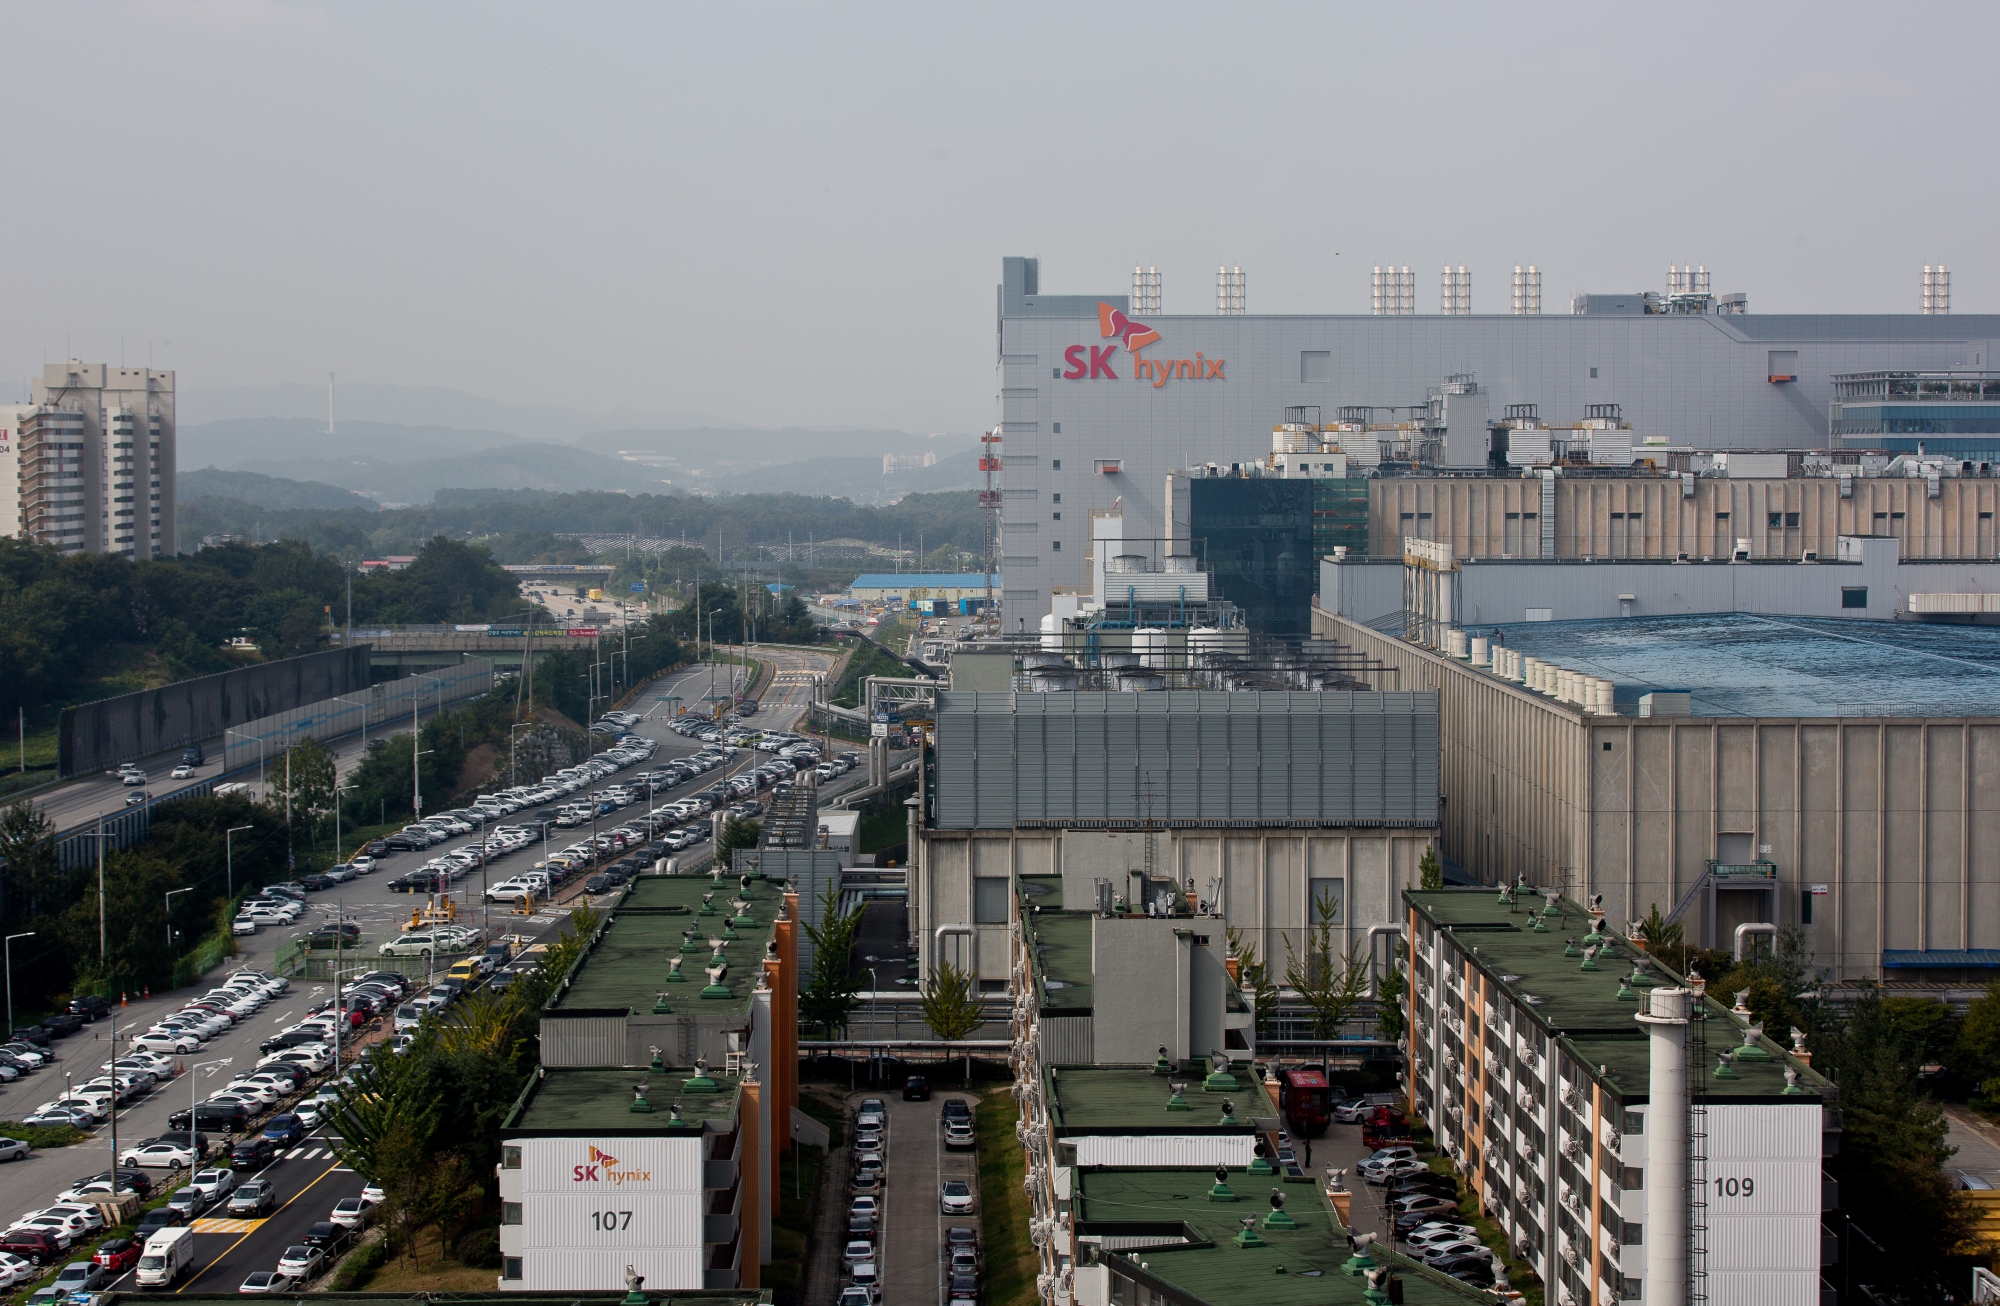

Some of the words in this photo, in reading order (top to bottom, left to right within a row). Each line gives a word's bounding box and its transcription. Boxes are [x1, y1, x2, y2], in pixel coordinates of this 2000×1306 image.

[1063, 345, 1118, 379] SK
[1134, 351, 1225, 388] hynix
[573, 1165, 599, 1182] SK
[607, 1167, 651, 1185] hynix
[1714, 1177, 1754, 1197] 109
[591, 1211, 633, 1231] 107
